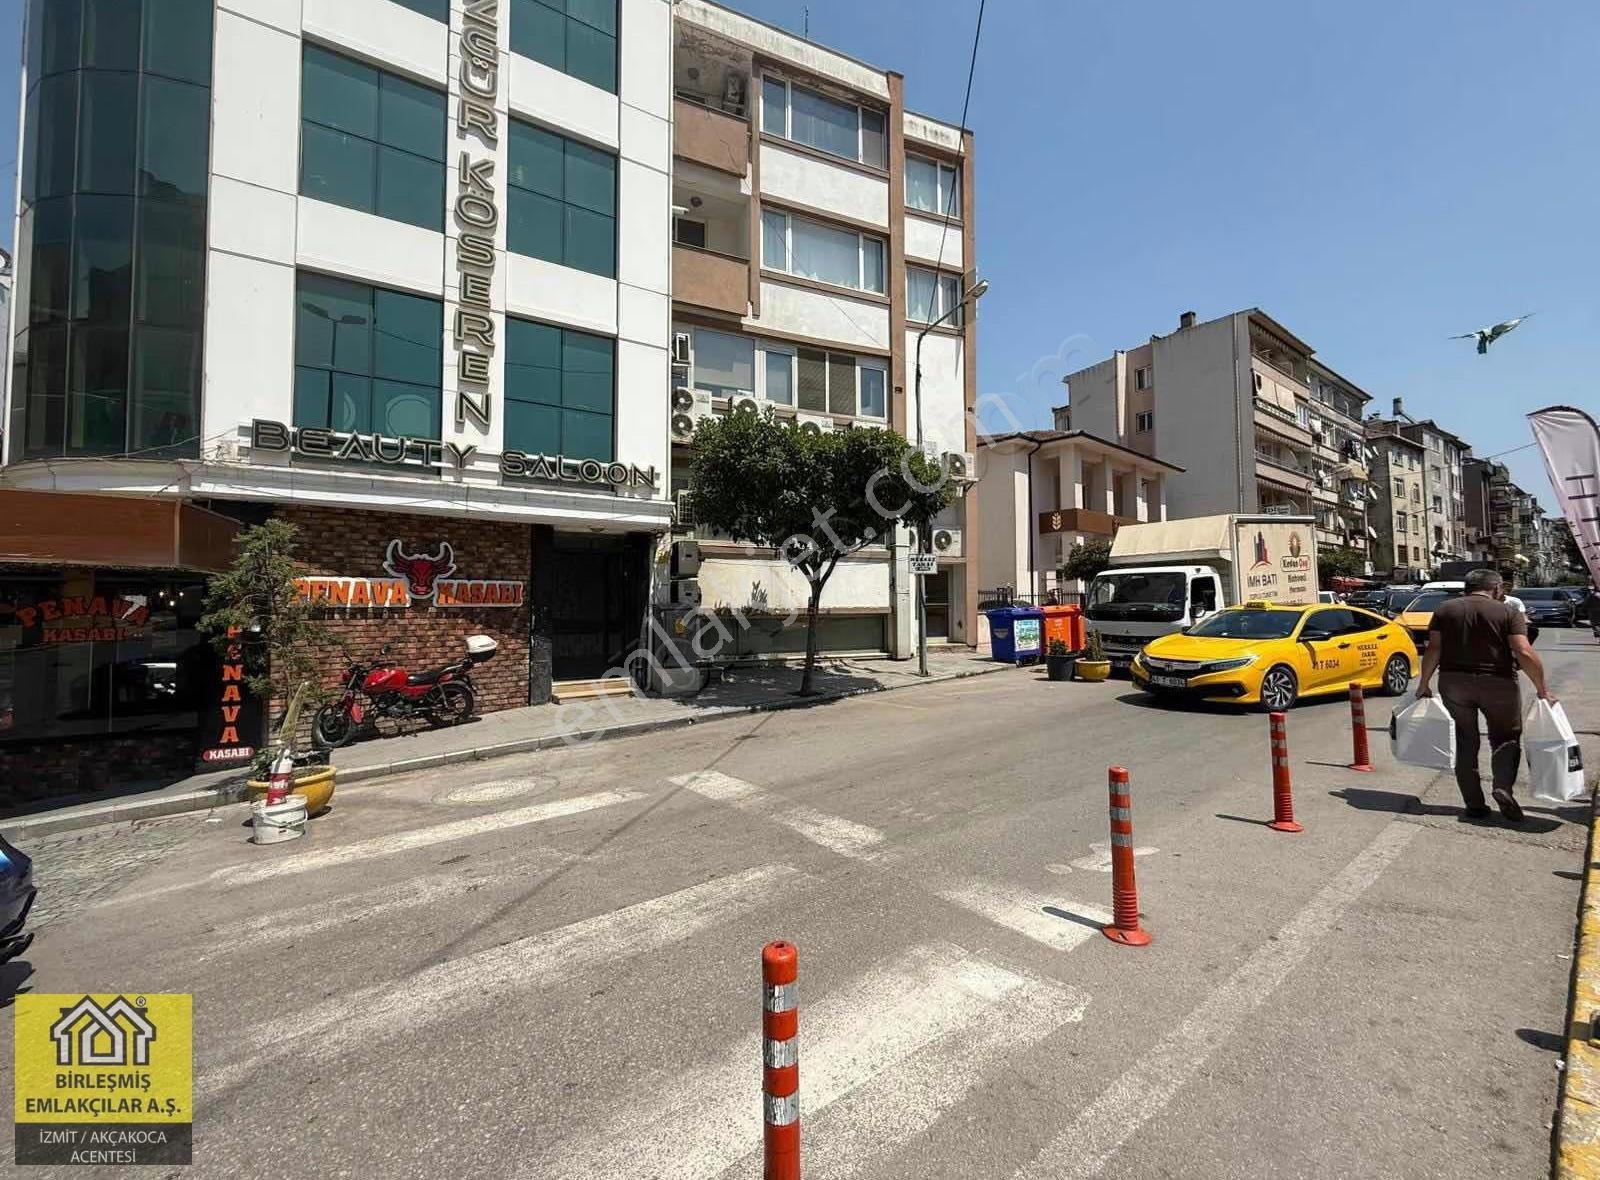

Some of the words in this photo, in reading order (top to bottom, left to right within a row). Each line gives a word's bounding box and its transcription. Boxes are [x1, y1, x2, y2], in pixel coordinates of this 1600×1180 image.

[455, 151, 499, 428] KÖSEREN
[251, 418, 479, 470] BEAUTY
[498, 450, 656, 489] SALOON
[291, 578, 410, 606] PENAVA
[436, 582, 522, 605] KASABI
[209, 747, 250, 760] KASABI
